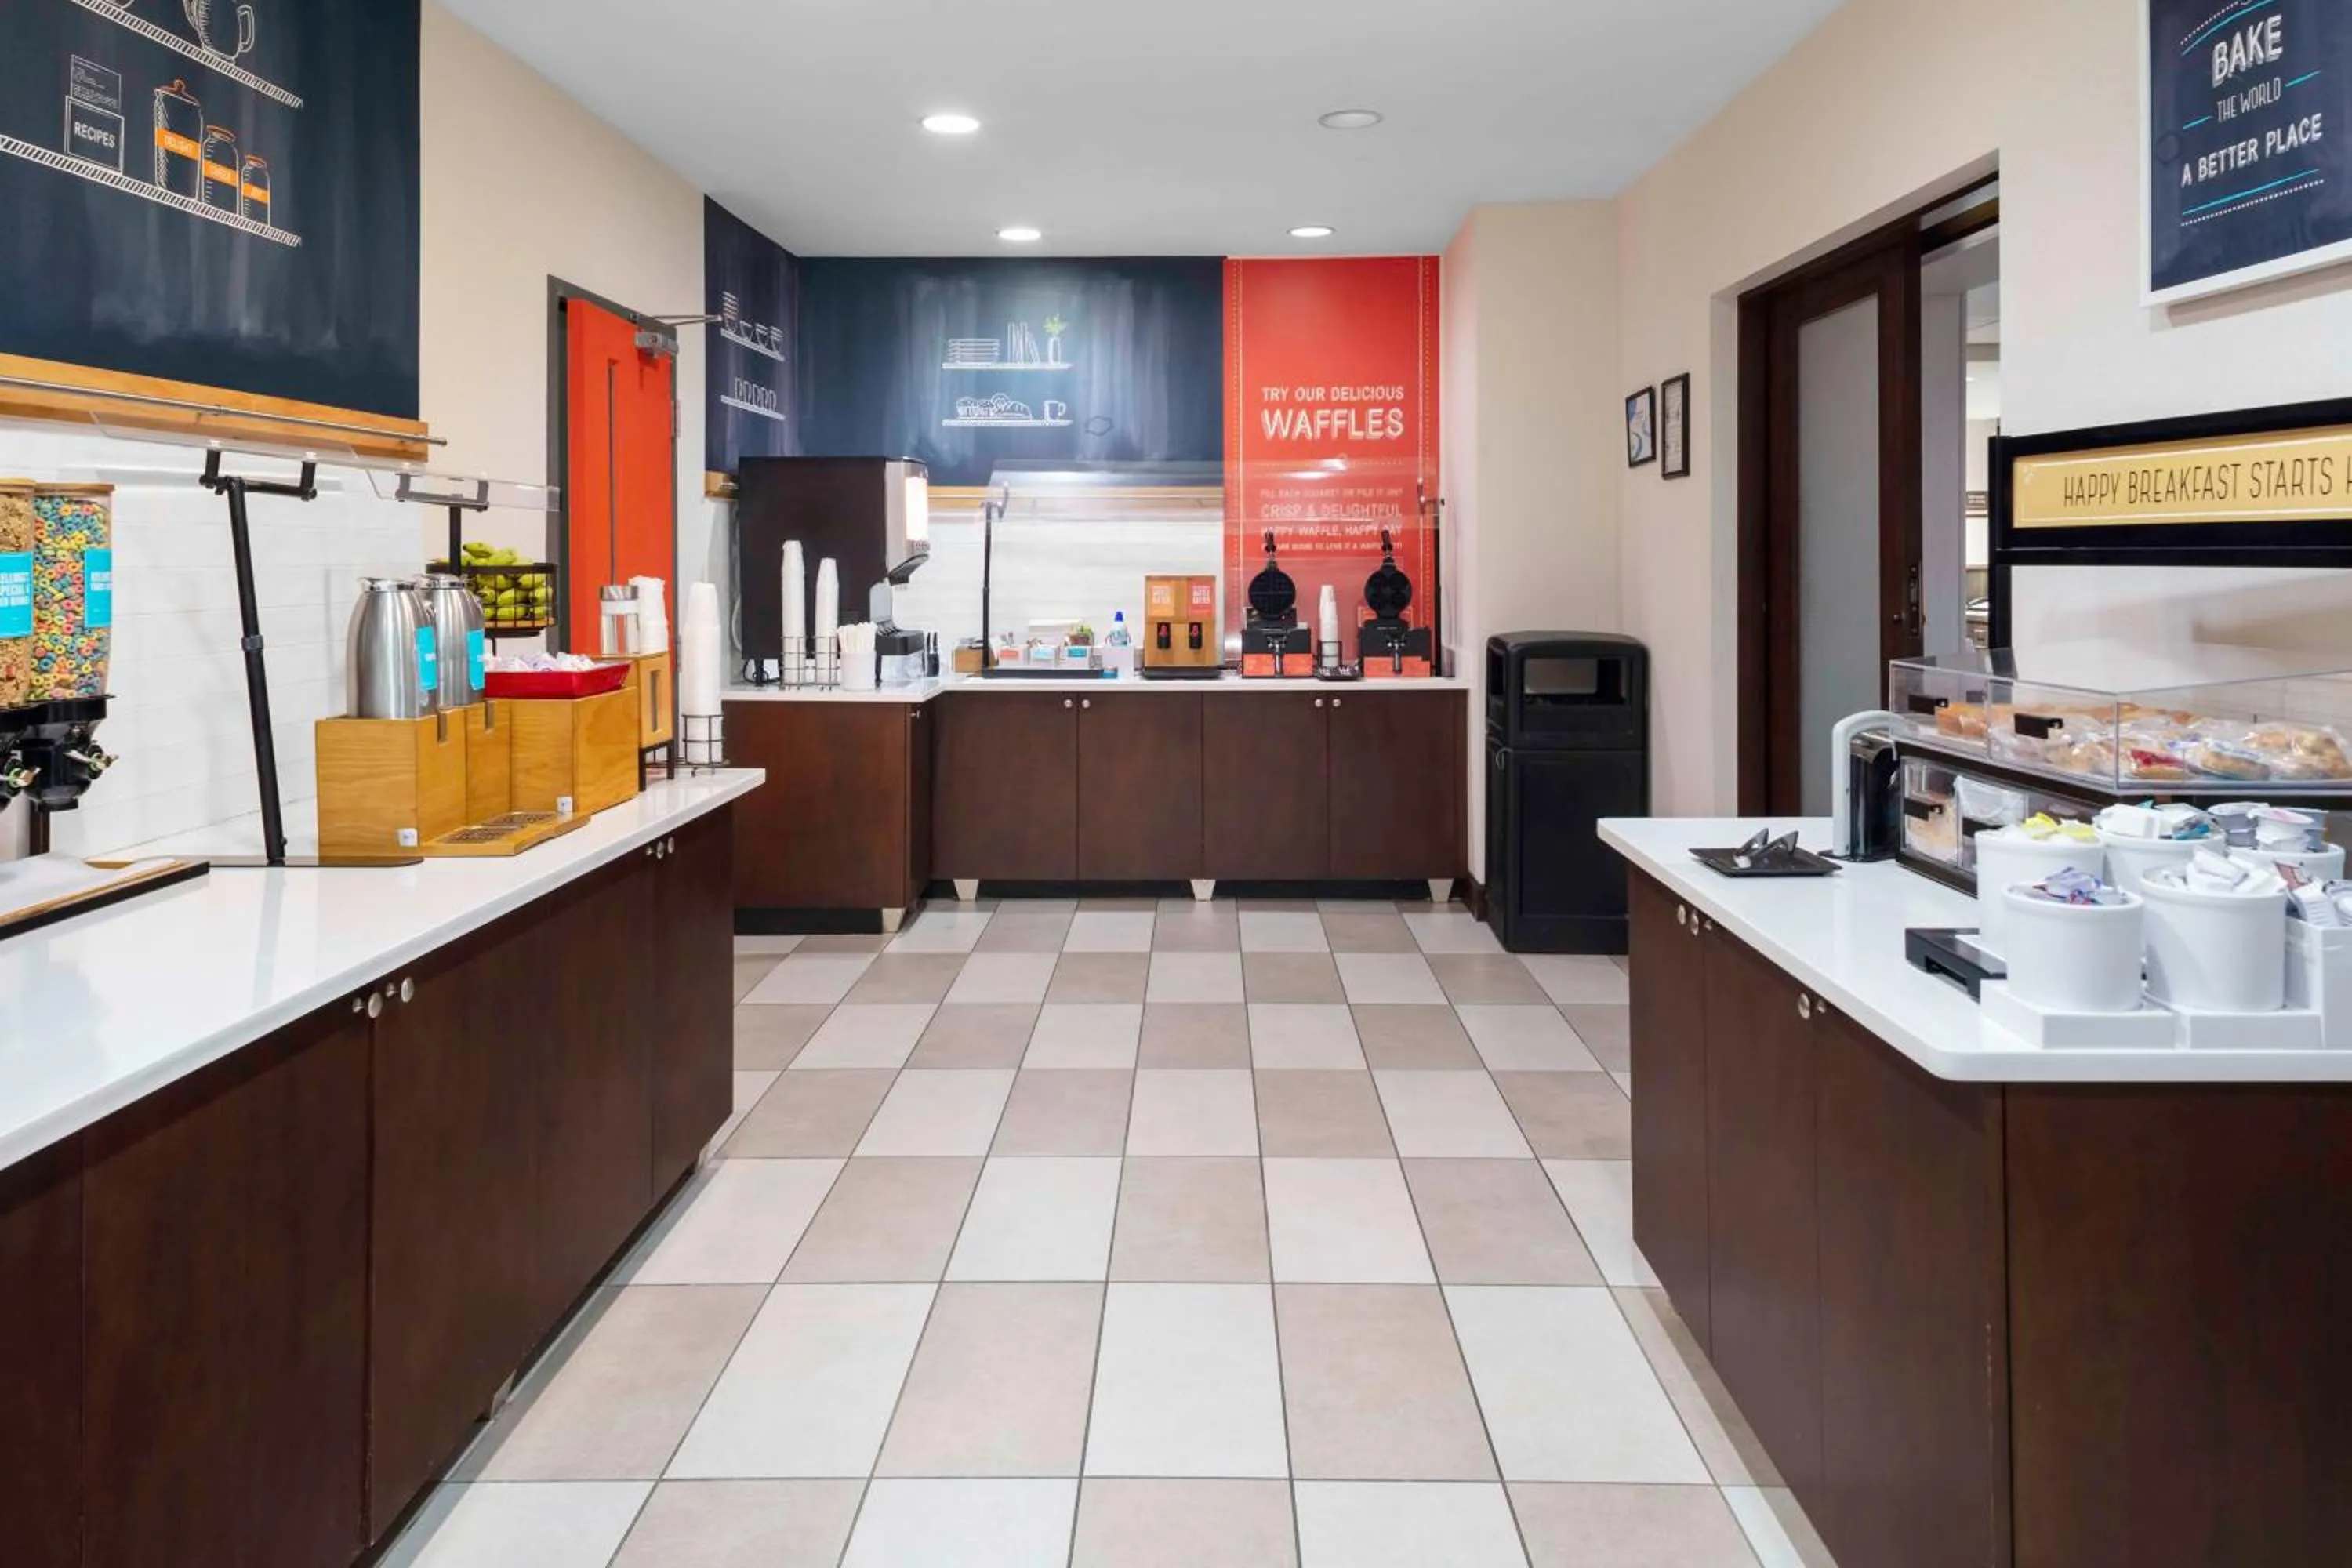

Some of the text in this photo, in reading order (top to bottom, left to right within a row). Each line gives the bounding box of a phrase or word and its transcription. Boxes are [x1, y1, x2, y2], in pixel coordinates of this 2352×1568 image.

[2212, 14, 2283, 88] BAKE
[2217, 76, 2281, 122] THE WORLD
[74, 121, 116, 148] RECIPES
[2180, 112, 2324, 188] A BETTER PLACE
[1261, 385, 1404, 401] TRY OUR DELICIOUS
[1261, 407, 1404, 441] WAFFLES
[2063, 473, 2120, 507] HAPPY
[2127, 463, 2241, 504] BREAKFAST
[2249, 456, 2334, 498] STARTS
[1261, 503, 1302, 517] CRISP
[1321, 503, 1403, 517] DELIGHTFUL
